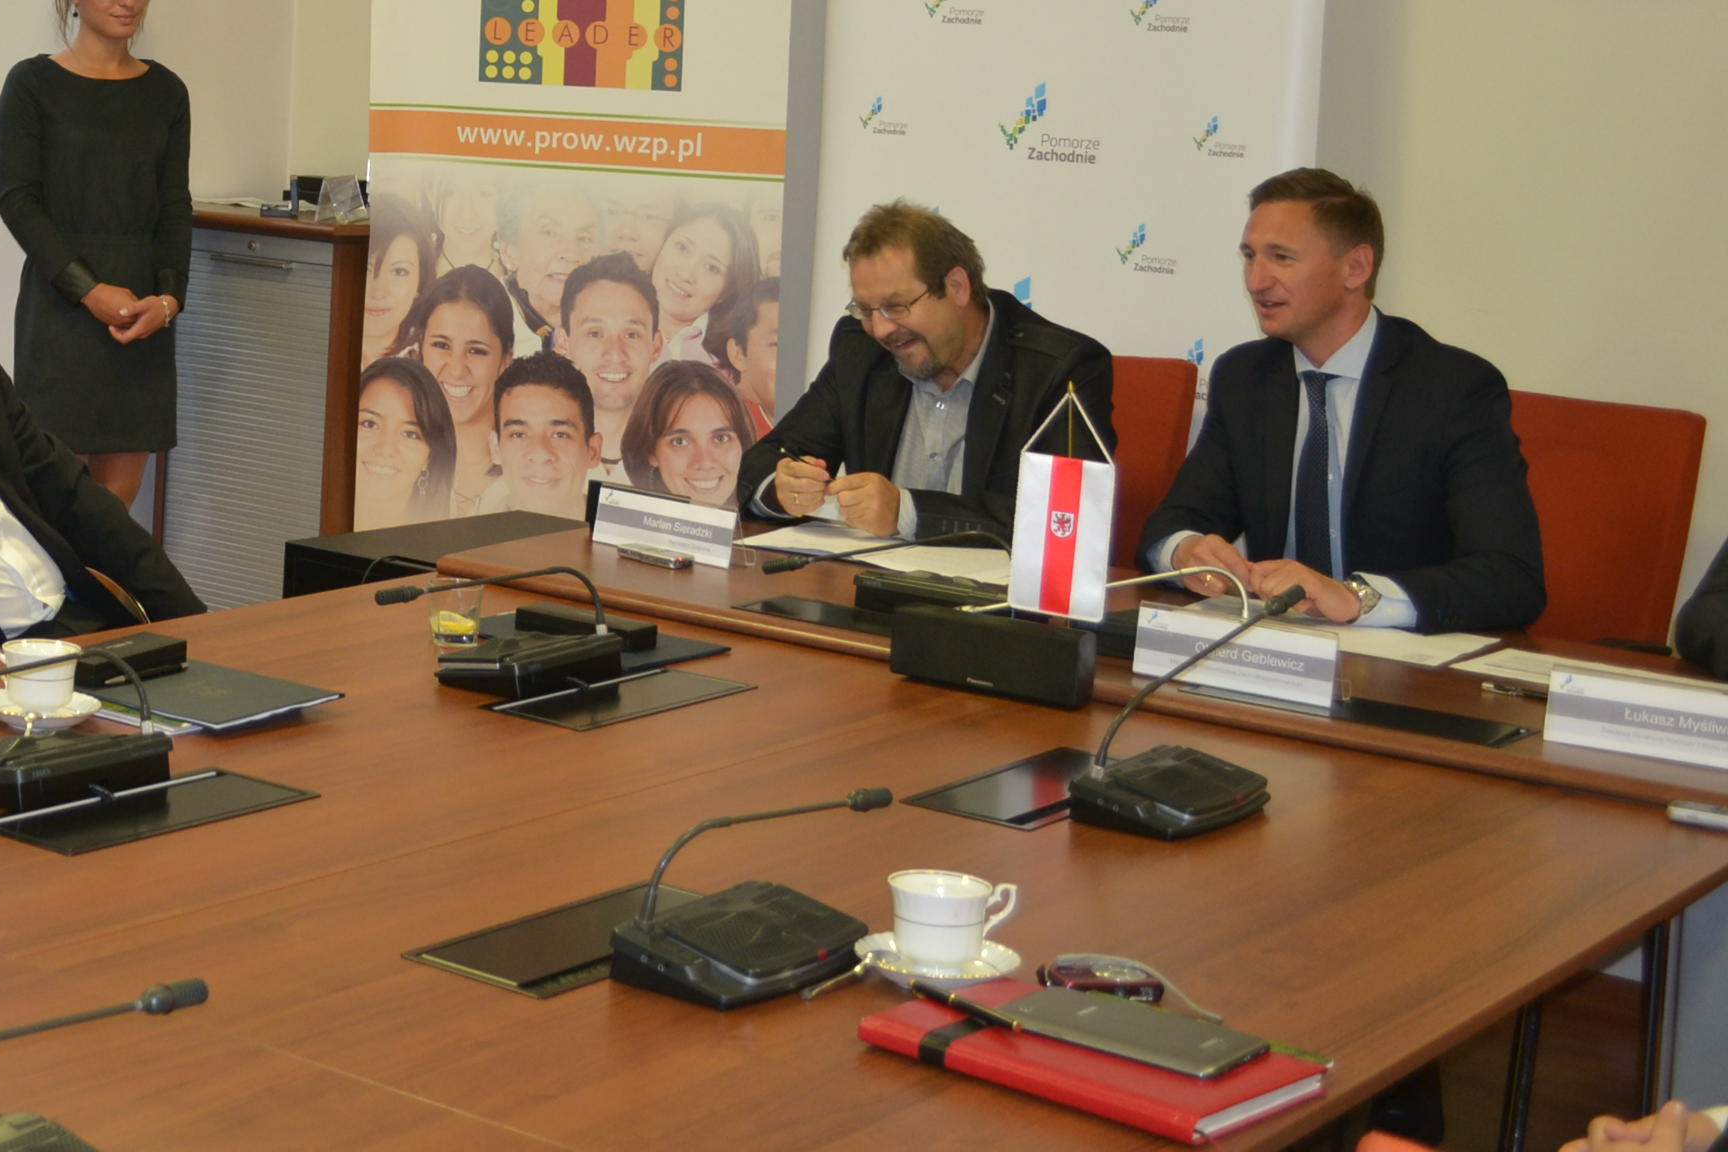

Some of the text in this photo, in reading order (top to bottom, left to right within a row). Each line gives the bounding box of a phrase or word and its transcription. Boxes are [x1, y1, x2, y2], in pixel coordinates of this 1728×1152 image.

[941, 16, 983, 25] Zachodnie
[949, 7, 985, 17] Pomorze
[1154, 14, 1190, 25] Pomorze
[493, 20, 676, 48] LEADER
[1147, 23, 1188, 33] Zachodnie
[457, 124, 703, 163] www.prow.wzp.pl
[1040, 133, 1101, 151] Pomorze
[1027, 147, 1097, 164] Zachodnie
[1133, 263, 1175, 275] Zachodnie
[643, 515, 713, 539] Marian Sieradzki
[1624, 707, 1728, 735] Łukasz Myśliw
